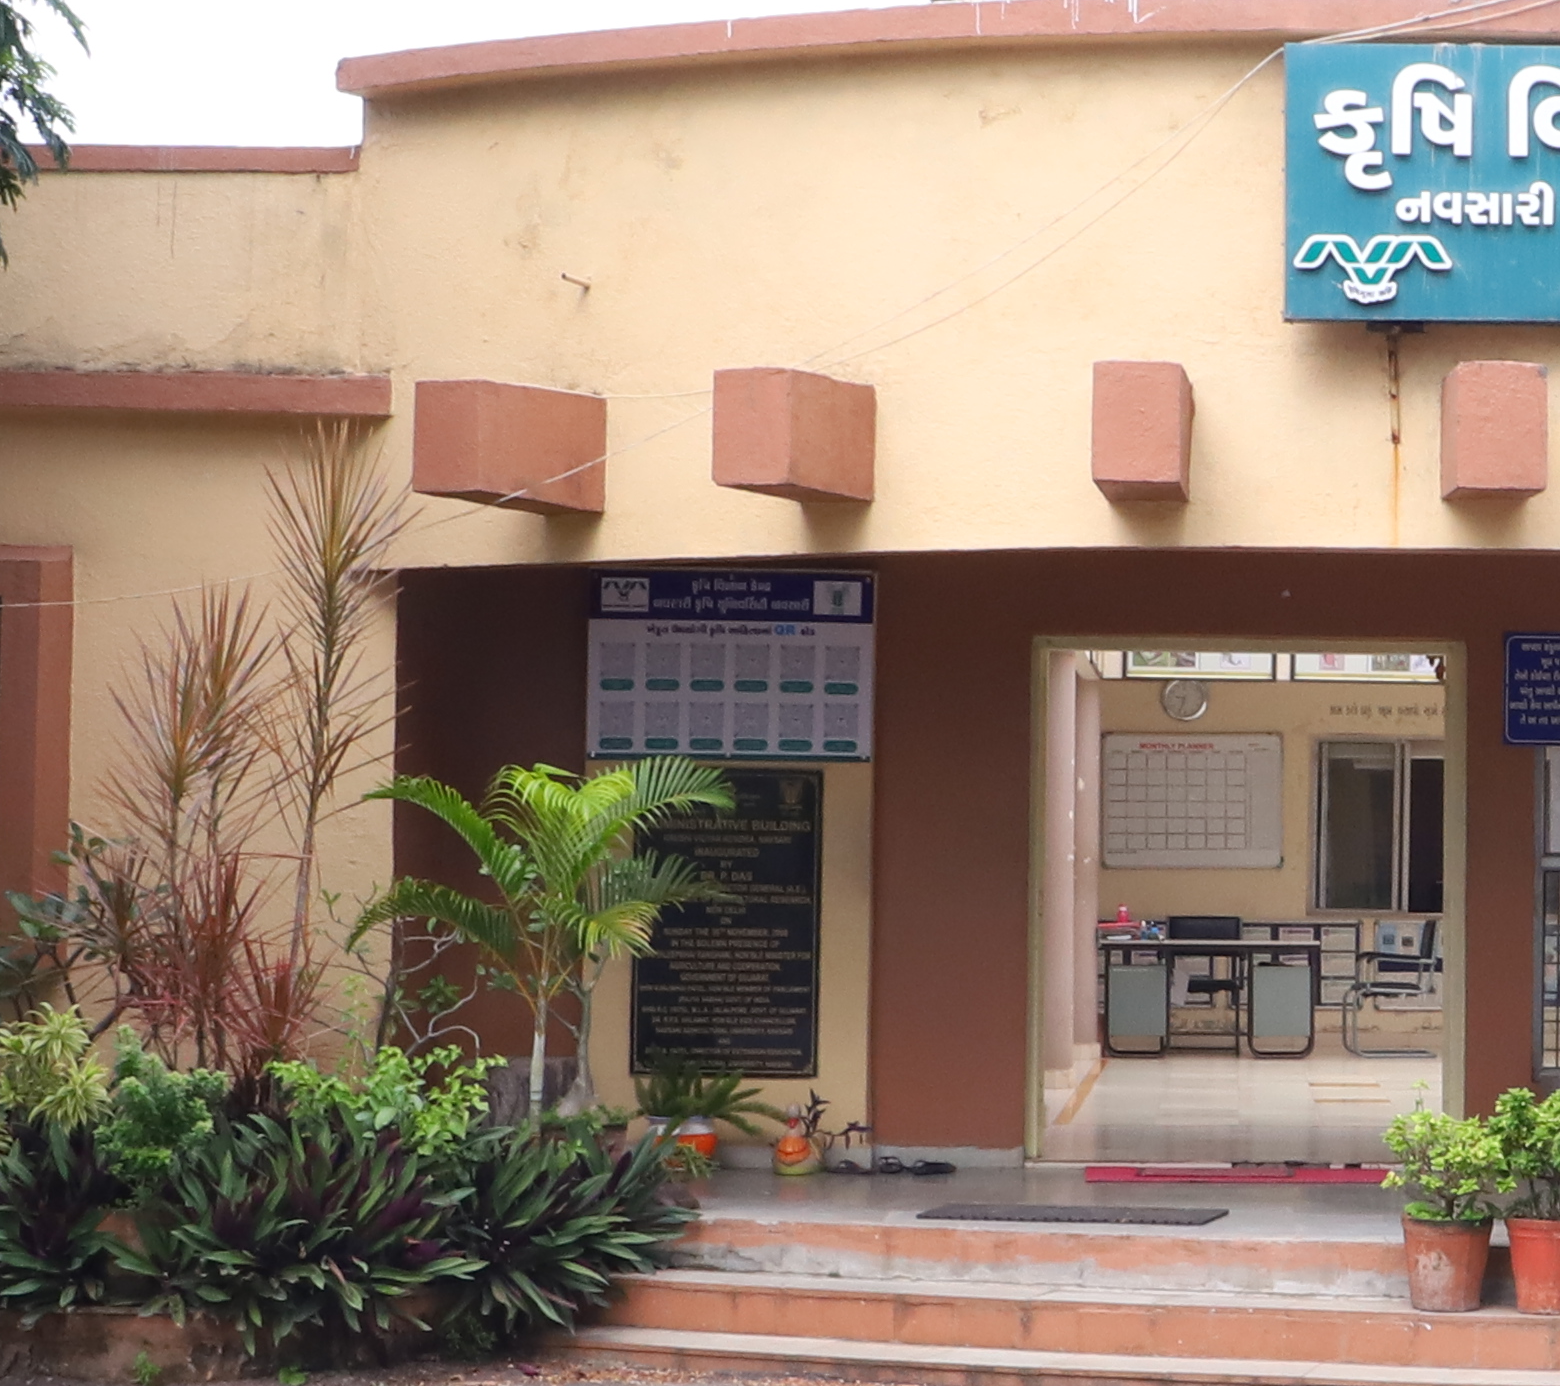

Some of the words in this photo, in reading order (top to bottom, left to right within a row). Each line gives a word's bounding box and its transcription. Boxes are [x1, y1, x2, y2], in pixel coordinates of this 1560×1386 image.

[1313, 62, 1473, 190] કૃષિ
[1395, 180, 1555, 226] નવસારી
[774, 624, 796, 636] QR
[1139, 742, 1176, 750] MONTHLY
[1177, 742, 1215, 750] PLANNER
[646, 818, 749, 831] MINISTRATIVE
[752, 819, 811, 832] BUILDING
[731, 871, 753, 882] DAS
